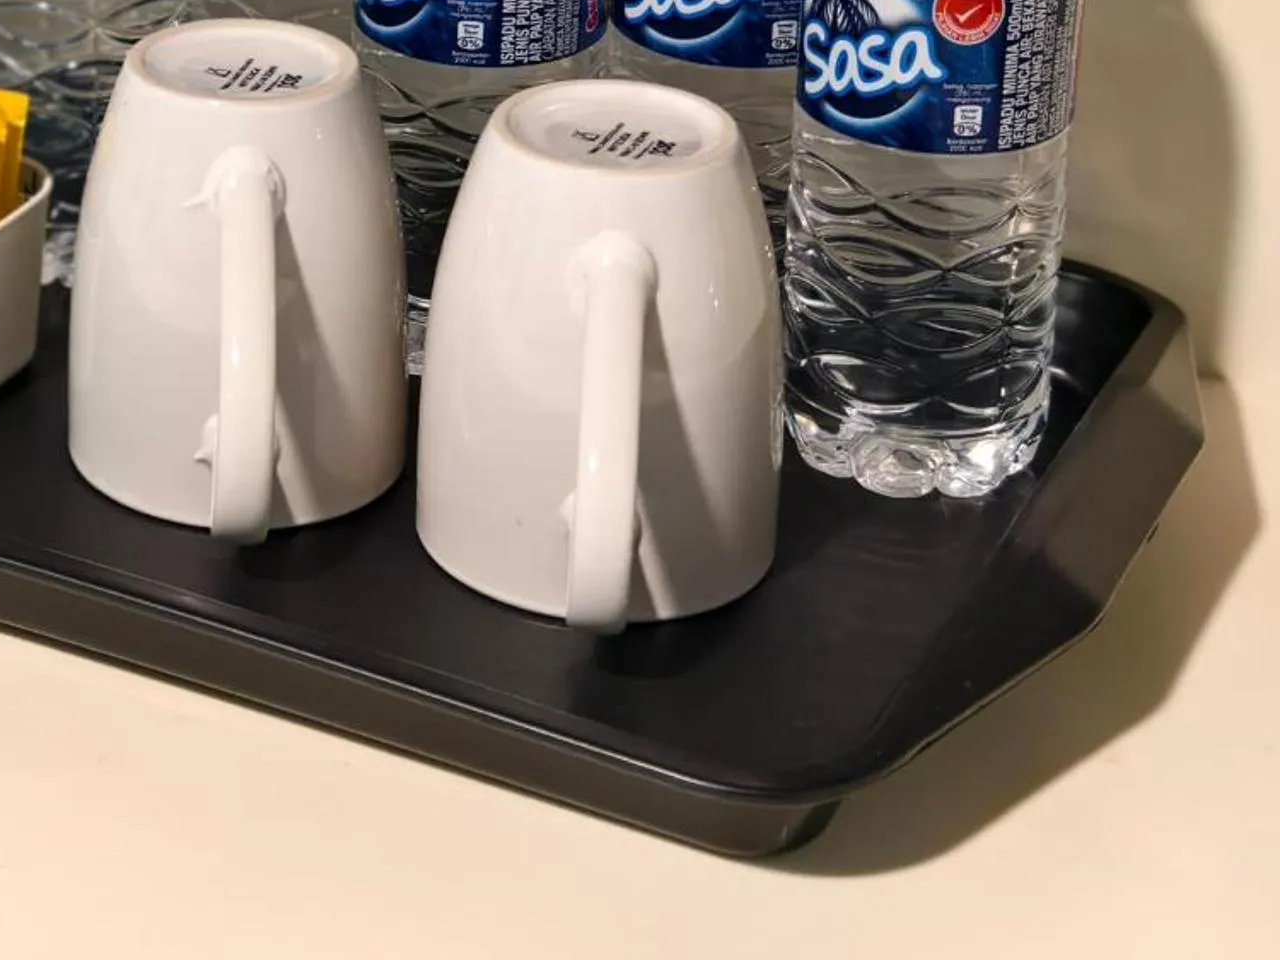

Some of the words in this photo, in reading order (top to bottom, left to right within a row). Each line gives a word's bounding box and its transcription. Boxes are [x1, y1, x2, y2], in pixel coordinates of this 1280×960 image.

[500, 17, 516, 65] ISIPADU
[530, 12, 544, 40] PAIP
[515, 27, 529, 63] JENIS
[528, 43, 542, 63] AIR
[803, 21, 942, 94] Sasa
[1002, 44, 1018, 95] MINIMA
[1016, 62, 1032, 106] PUNCA
[1029, 55, 1043, 88] YANG
[1027, 89, 1040, 117] PAIP
[998, 98, 1014, 149] ISIPADU
[1013, 110, 1027, 146] JENIS
